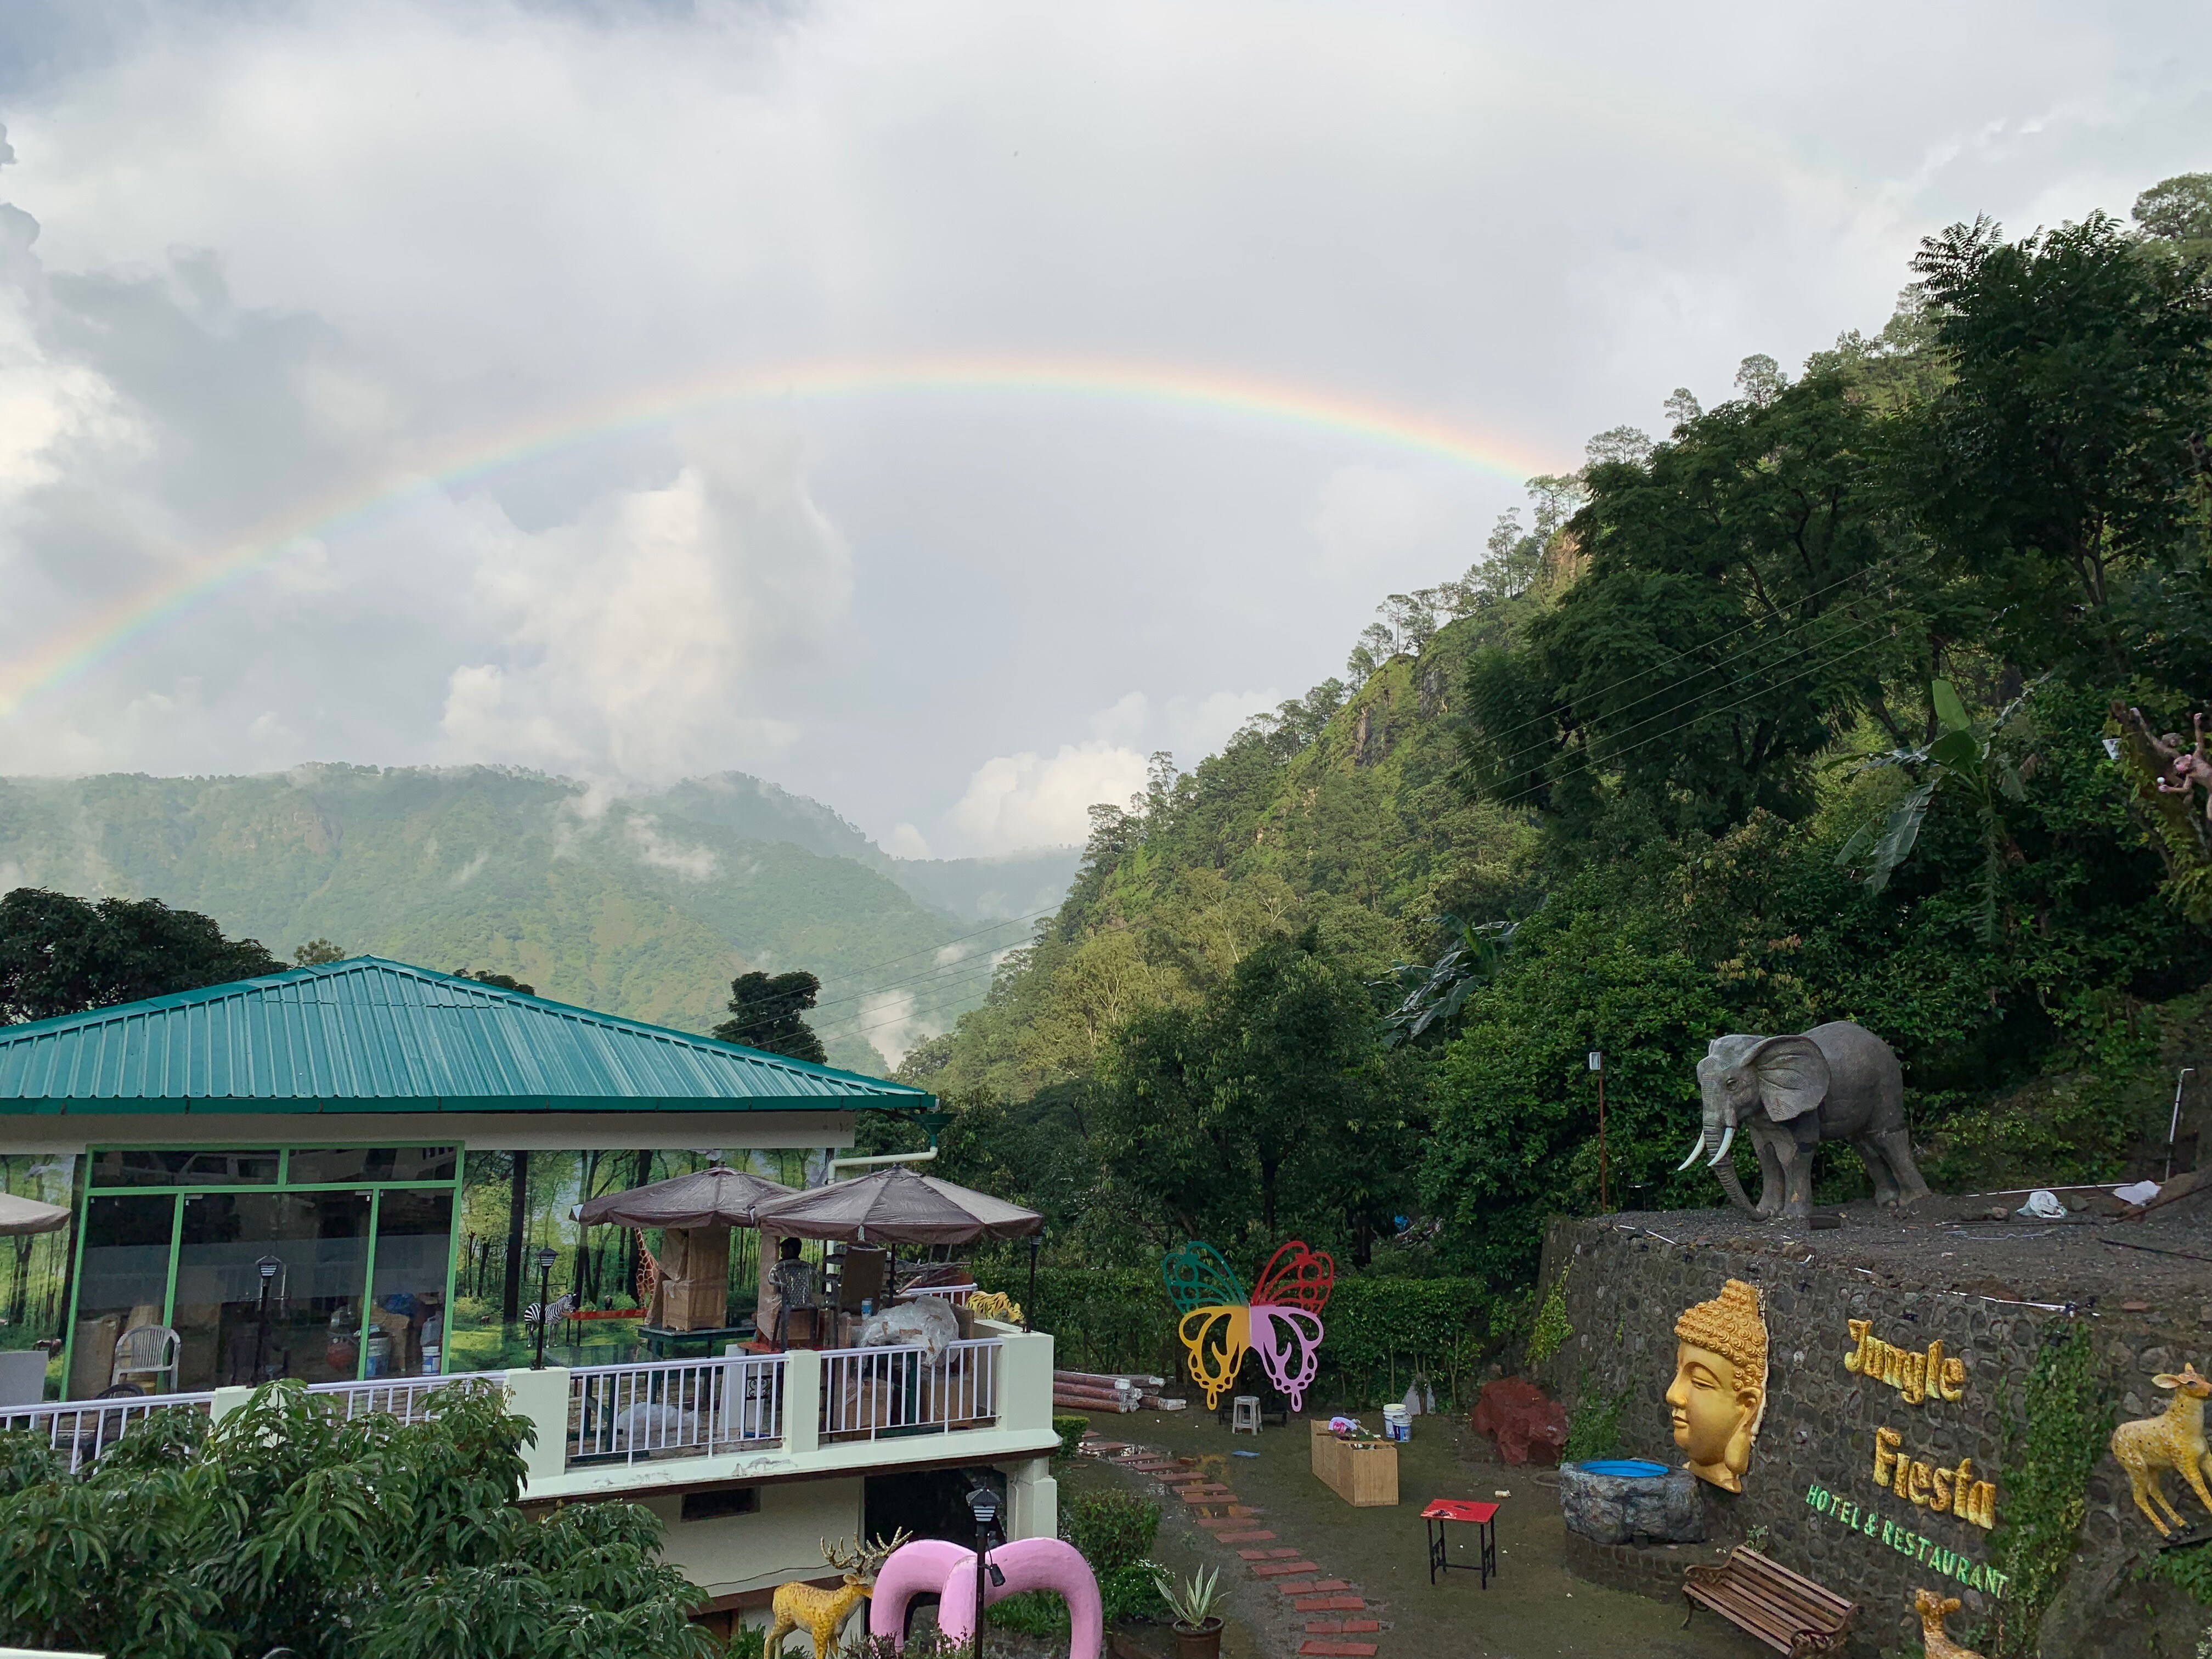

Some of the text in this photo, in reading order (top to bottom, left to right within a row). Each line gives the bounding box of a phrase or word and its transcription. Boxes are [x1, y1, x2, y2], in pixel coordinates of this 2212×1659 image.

[1844, 1319, 1965, 1404] Jungle
[1872, 1426, 1996, 1530] Fiesta
[1805, 1484, 2010, 1598] HOTEL & RESTAURANT
